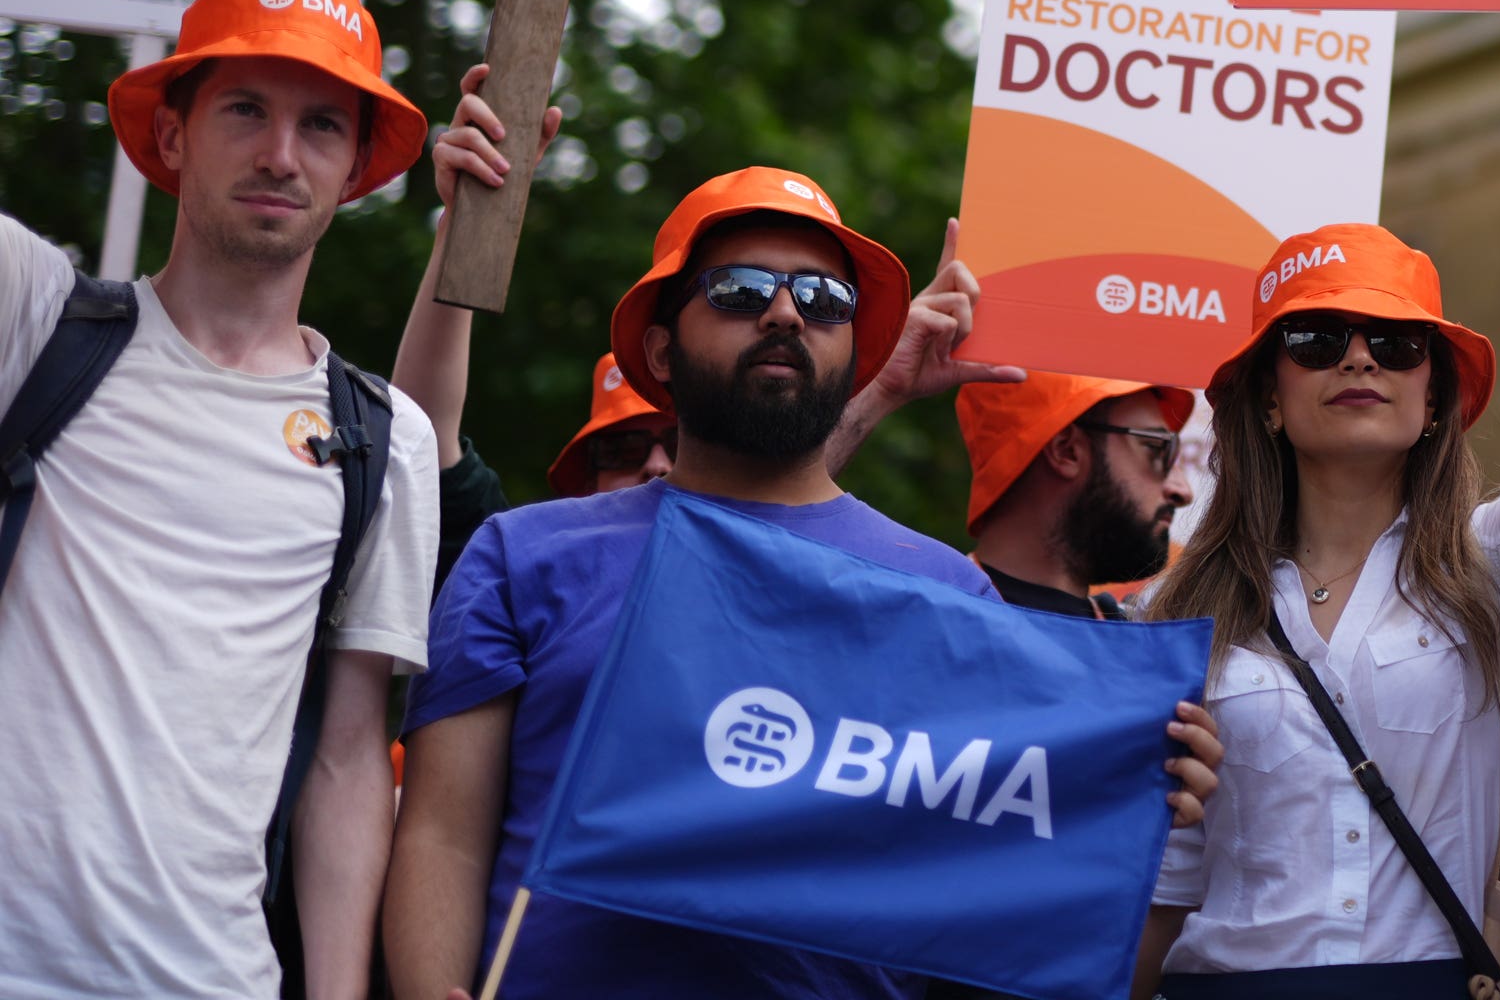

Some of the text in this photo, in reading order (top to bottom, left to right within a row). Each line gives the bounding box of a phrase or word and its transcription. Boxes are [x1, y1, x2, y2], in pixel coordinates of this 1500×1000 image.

[1294, 28, 1371, 66] FOR
[999, 33, 1364, 136] DOCTORS
[1279, 243, 1346, 285] BMA
[1138, 281, 1227, 324] BMA
[814, 717, 1055, 841] BMA
